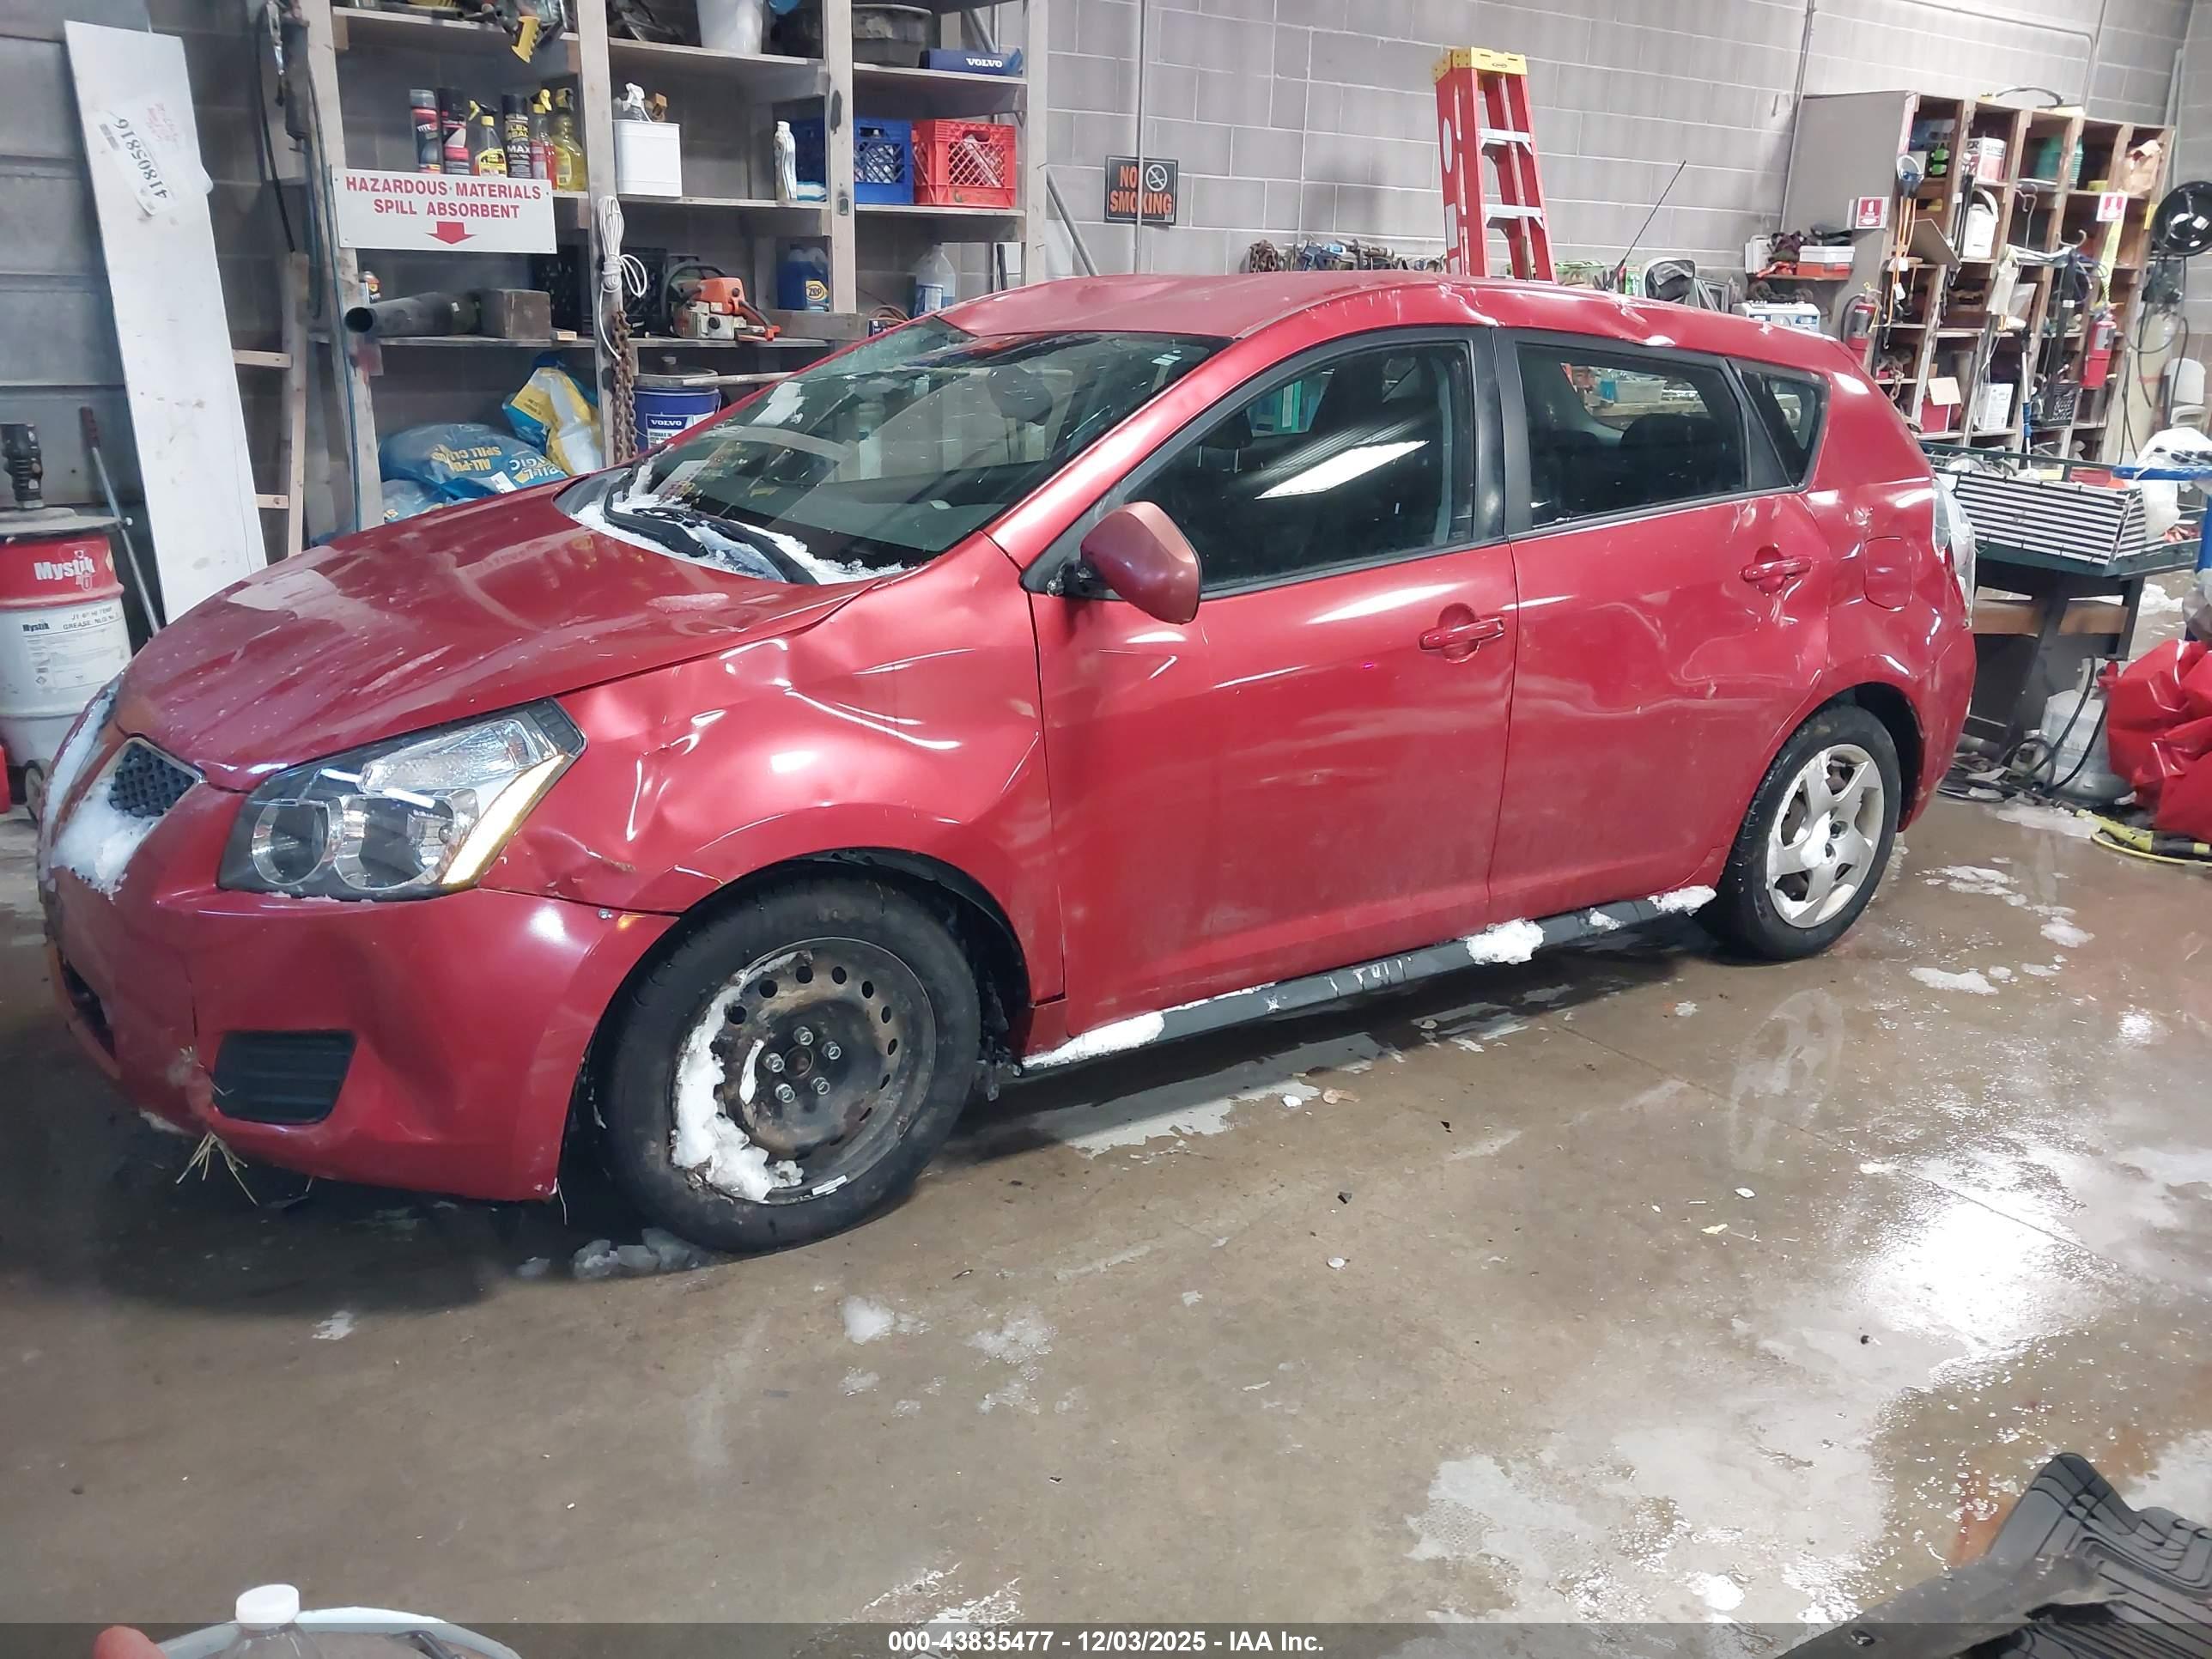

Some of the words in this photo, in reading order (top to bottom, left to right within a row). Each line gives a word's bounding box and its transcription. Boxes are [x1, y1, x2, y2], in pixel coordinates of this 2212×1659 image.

[966, 58, 1003, 68] VOLVO
[112, 118, 167, 198] 41805816
[507, 145, 530, 154] MAX
[1120, 165, 1138, 188] NO
[345, 176, 447, 196] HAZARDOUS
[455, 182, 542, 200] MATERIALS
[374, 198, 417, 215] SPILL
[426, 203, 520, 219] ABSORBENT
[1109, 190, 1173, 214] SMOKING
[522, 465, 562, 480] PILL
[33, 556, 96, 580] Mystik
[22, 622, 51, 632] Mystik
[63, 620, 90, 631] GREASE
